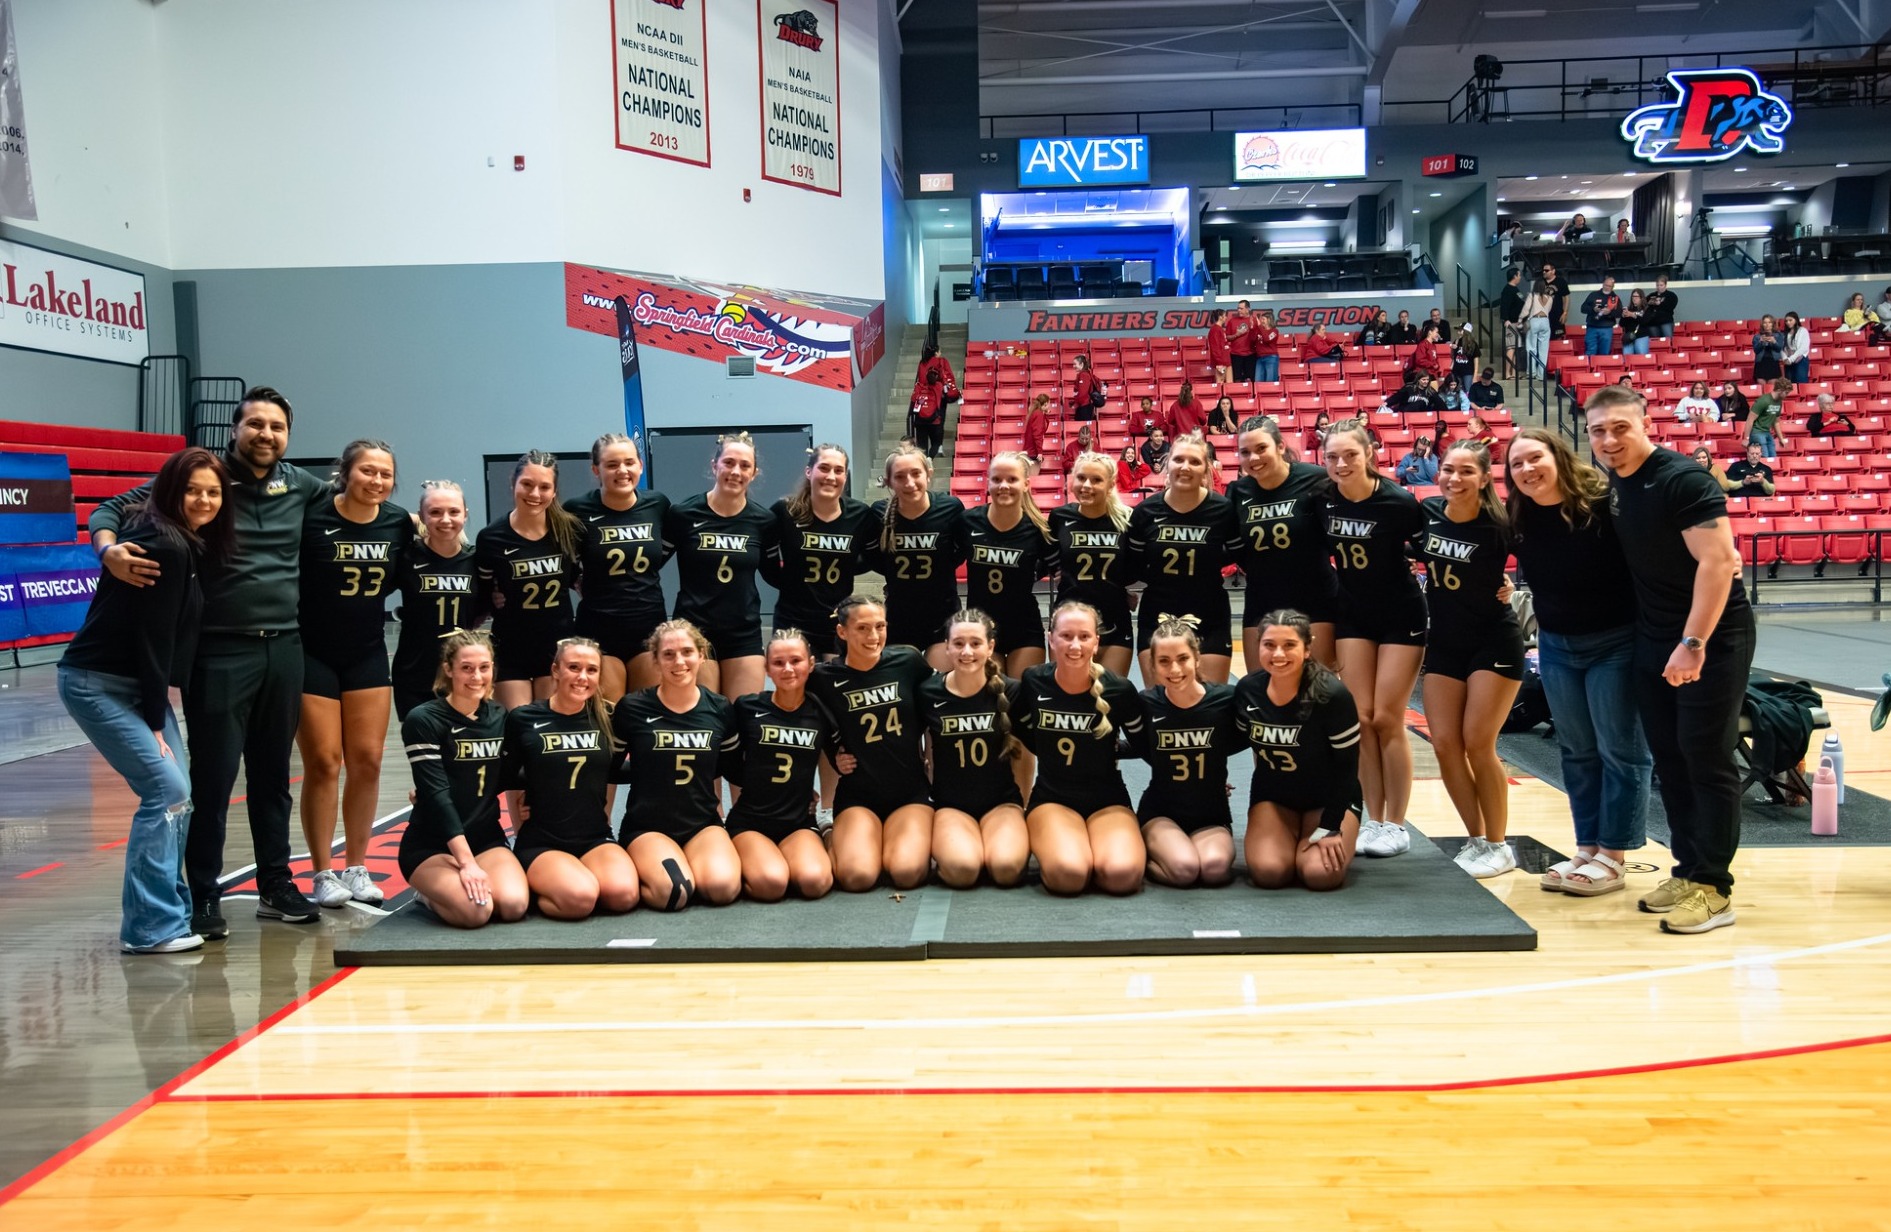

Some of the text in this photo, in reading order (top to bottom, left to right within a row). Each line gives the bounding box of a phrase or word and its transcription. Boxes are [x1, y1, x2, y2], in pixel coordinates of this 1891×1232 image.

[637, 22, 683, 46] NCAA DII
[780, 23, 822, 51] DRURY
[621, 38, 698, 67] MEN'S BASKETBALL
[628, 63, 695, 99] NATIONAL
[788, 66, 811, 82] NAIA
[767, 78, 832, 104] MEN'S BASKETBALL
[622, 91, 702, 128] CHAMPIONS
[773, 101, 829, 134] NATIONAL
[650, 132, 678, 151] 2013
[768, 127, 835, 160] CHAMPIONS
[790, 163, 815, 181] 1979
[1025, 138, 1144, 182] ARVEST
[1428, 158, 1449, 172] 101
[1459, 158, 1475, 170] 102
[927, 177, 947, 188] 101
[3, 263, 145, 331] Lakeland
[25, 311, 133, 342] OFFICE SYSTEMS
[634, 292, 718, 335] Springfield
[714, 314, 779, 351] Cardinals
[1277, 305, 1380, 326] SECTION
[1250, 502, 1293, 521] PNW
[604, 525, 651, 542] PNW
[1074, 533, 1118, 547] PNW
[1161, 527, 1206, 542] PNW
[1250, 522, 1291, 551] 28
[1331, 518, 1372, 537] PNW
[340, 544, 388, 560] PNW
[702, 536, 746, 550] PNW
[806, 534, 850, 551] PNW
[895, 535, 936, 549] PNW
[1428, 536, 1471, 560] PNW
[515, 557, 561, 577] PNW
[606, 546, 650, 576] 26
[895, 555, 933, 580] 23
[976, 547, 1020, 566] PNW
[1076, 553, 1116, 581] 27
[1162, 548, 1196, 576] 21
[1336, 542, 1369, 570] 18
[340, 566, 386, 597] 33
[717, 555, 734, 584] 6
[804, 556, 841, 584] 36
[987, 568, 1004, 594] 8
[1428, 561, 1461, 591] 16
[21, 578, 87, 599] TREVECCA
[424, 576, 469, 591] PNW
[522, 580, 561, 609] 22
[436, 596, 461, 626] 11
[849, 685, 899, 709] PNW
[860, 707, 903, 744] 24
[943, 715, 994, 733] PNW
[1041, 711, 1093, 731] PNW
[546, 732, 598, 750] PNW
[657, 732, 710, 749] PNW
[763, 727, 815, 747] PNW
[1159, 730, 1210, 748] PNW
[1252, 724, 1298, 745] PNW
[460, 740, 502, 758] PNW
[954, 737, 989, 768] 10
[1057, 737, 1076, 766] 9
[567, 756, 587, 790] 7
[675, 754, 696, 786] 5
[771, 753, 793, 784] 3
[1169, 753, 1205, 781] 31
[477, 765, 487, 797] 1
